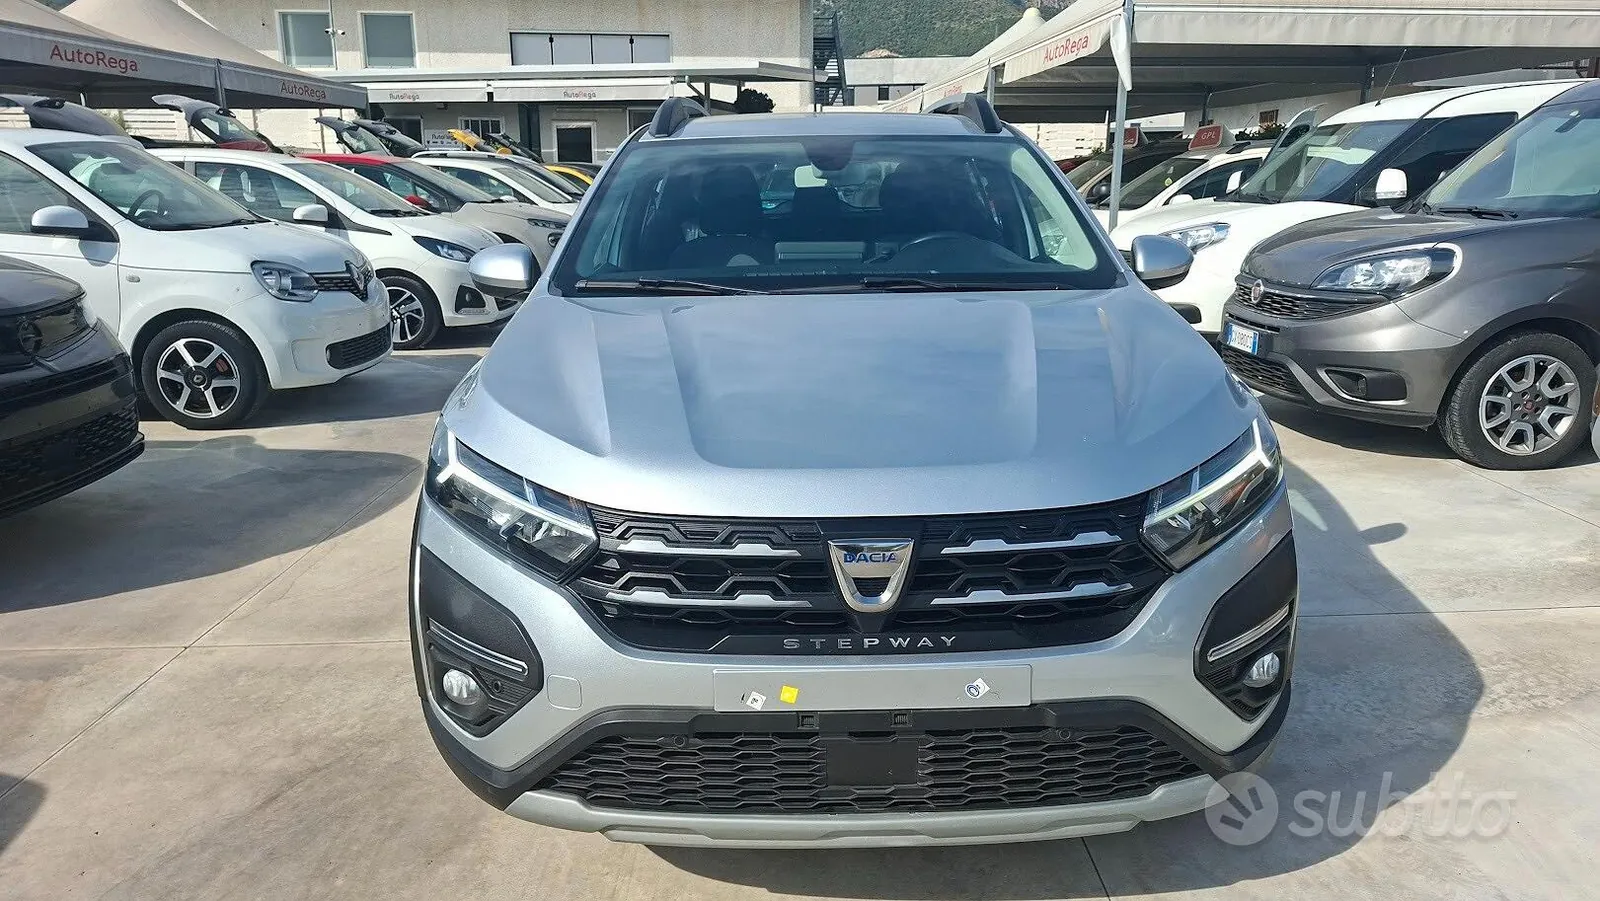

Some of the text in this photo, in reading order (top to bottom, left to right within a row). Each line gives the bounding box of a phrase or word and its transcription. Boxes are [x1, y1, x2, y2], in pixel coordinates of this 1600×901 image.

[1043, 35, 1089, 64] AutoRega
[50, 44, 138, 74] AutoRega
[280, 81, 326, 101] AutoRega
[1200, 130, 1216, 141] GPL
[843, 552, 897, 563] DACIA
[783, 636, 956, 649] STEPWAY
